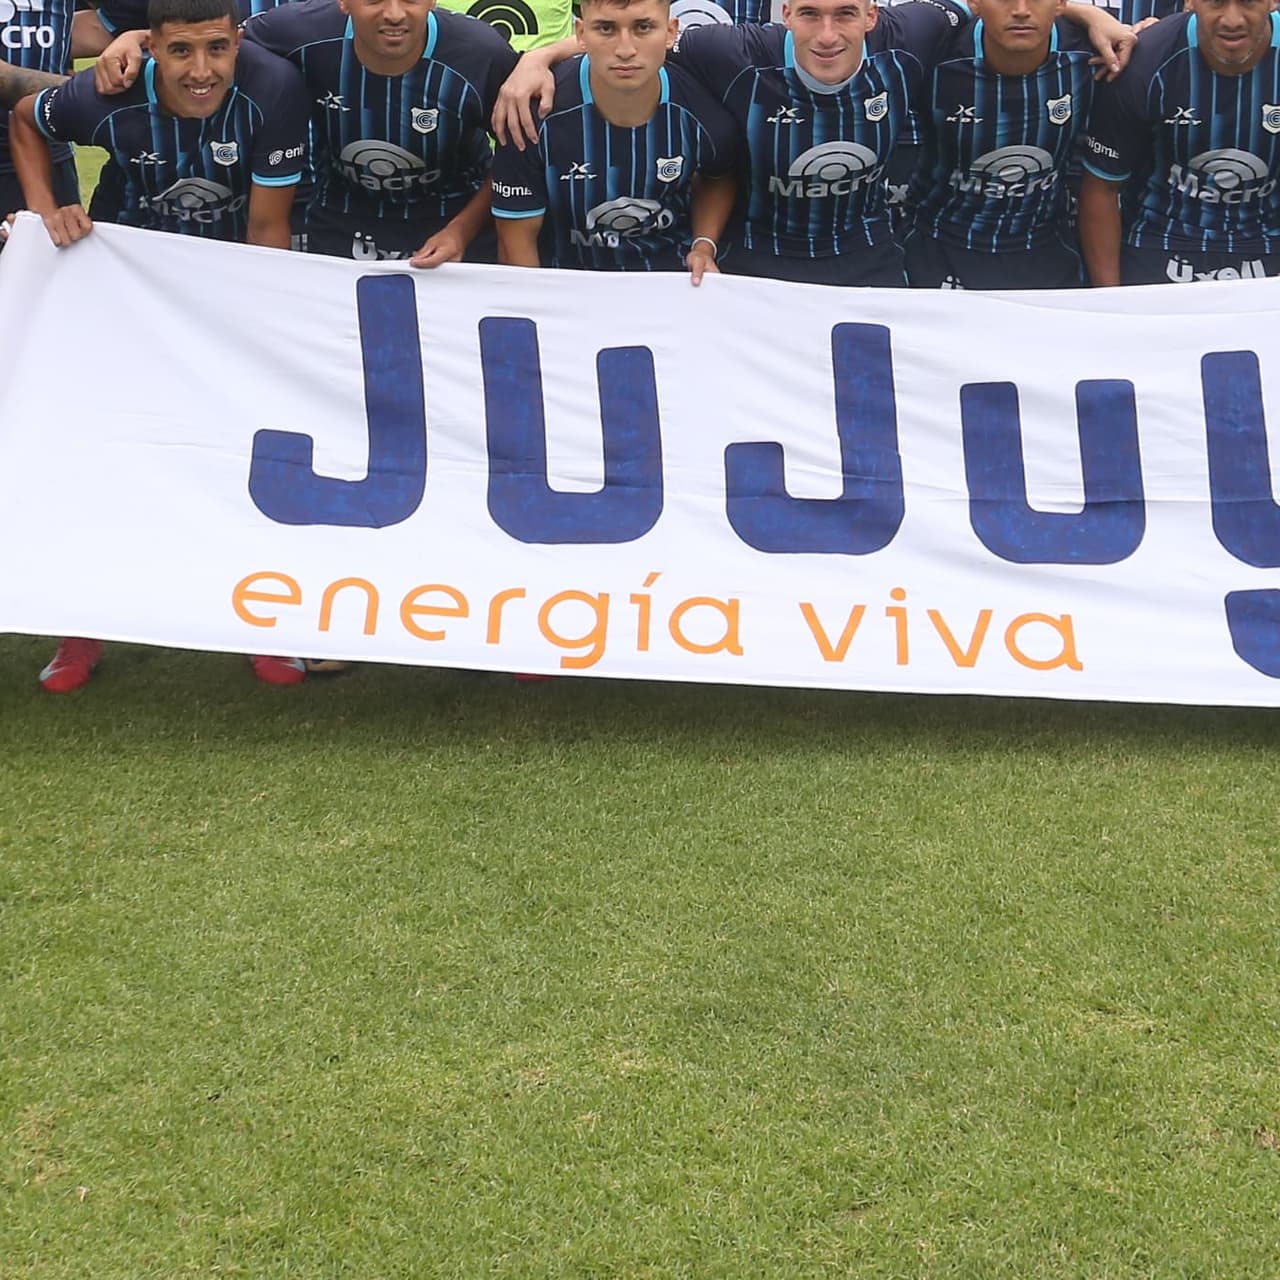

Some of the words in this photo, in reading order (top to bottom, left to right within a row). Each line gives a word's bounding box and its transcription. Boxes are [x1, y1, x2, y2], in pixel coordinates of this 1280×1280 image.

[769, 163, 886, 199] Macro
[948, 169, 1059, 200] Macro
[1167, 162, 1277, 205] Macro
[232, 572, 744, 669] energía
[800, 588, 1083, 671] viva
